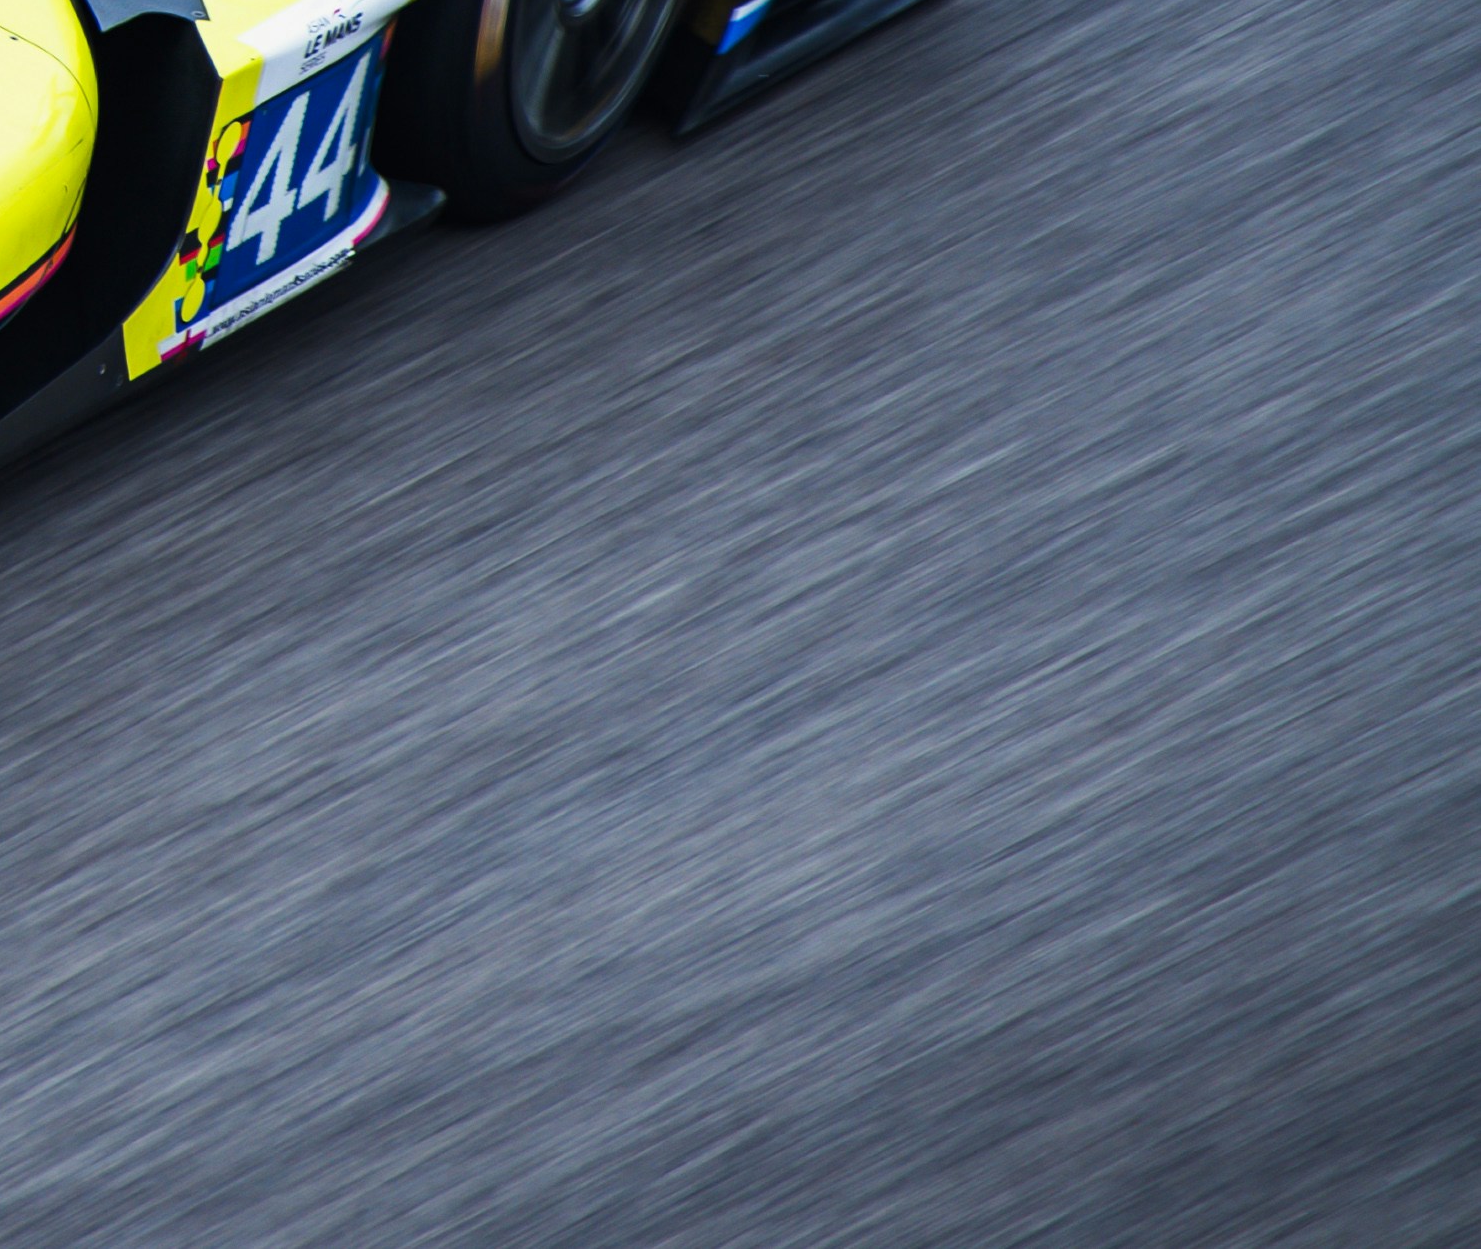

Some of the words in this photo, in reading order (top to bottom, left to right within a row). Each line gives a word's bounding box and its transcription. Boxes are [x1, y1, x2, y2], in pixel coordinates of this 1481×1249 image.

[303, 33, 323, 59] LE
[322, 11, 364, 50] MANS
[225, 50, 373, 267] 44
